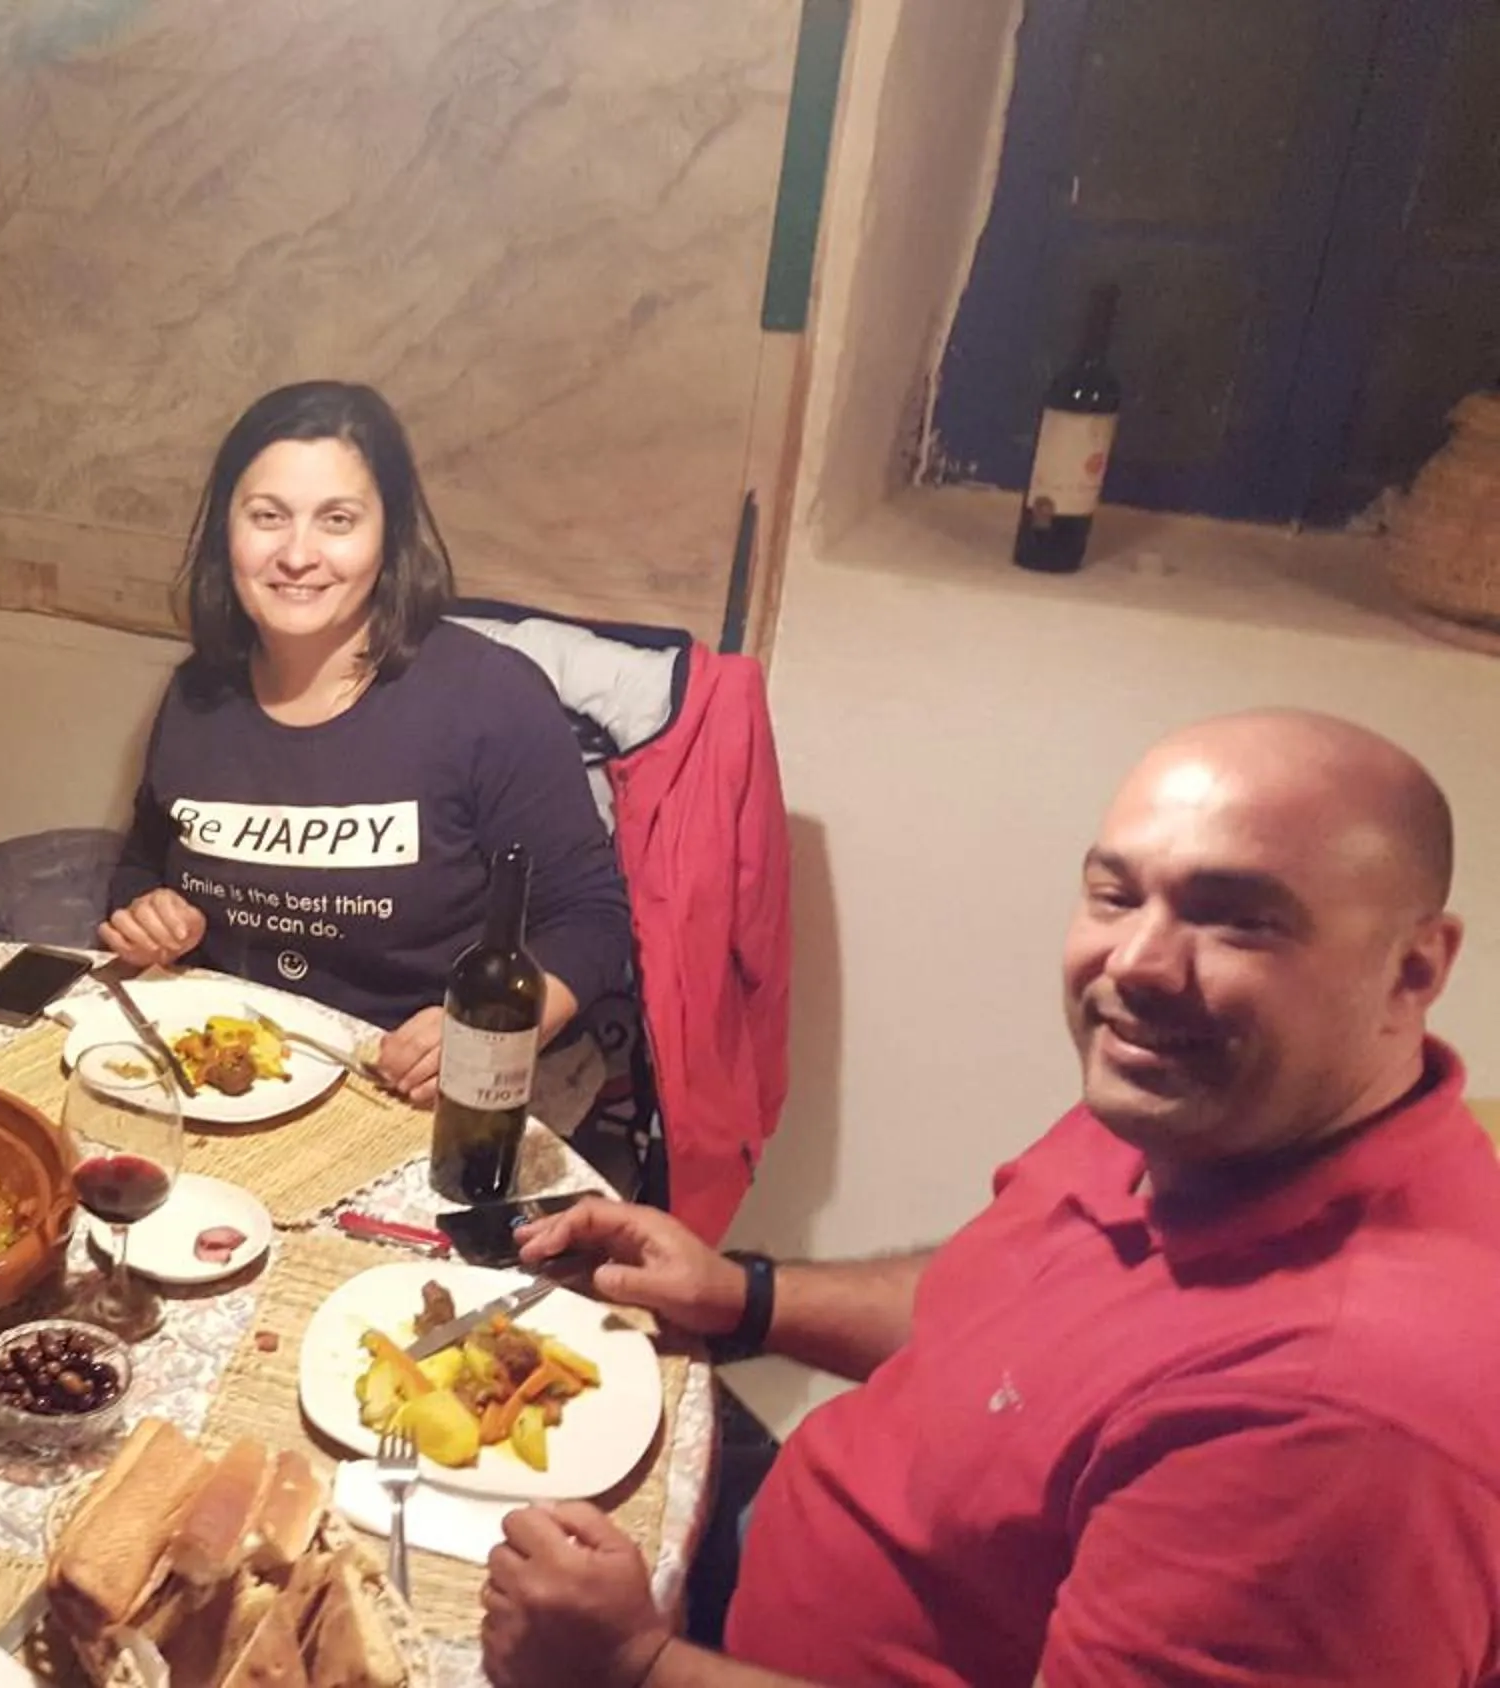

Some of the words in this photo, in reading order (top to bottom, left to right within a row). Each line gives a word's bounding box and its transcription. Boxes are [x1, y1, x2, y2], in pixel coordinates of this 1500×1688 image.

[176, 806, 222, 845] Be
[232, 815, 405, 855] HAPPY.
[181, 871, 226, 898] Smile
[230, 884, 243, 901] is
[247, 888, 280, 907] the
[285, 892, 328, 914] best
[335, 895, 393, 919] thing
[226, 907, 261, 927] you
[267, 914, 304, 934] can
[310, 917, 346, 939] do.
